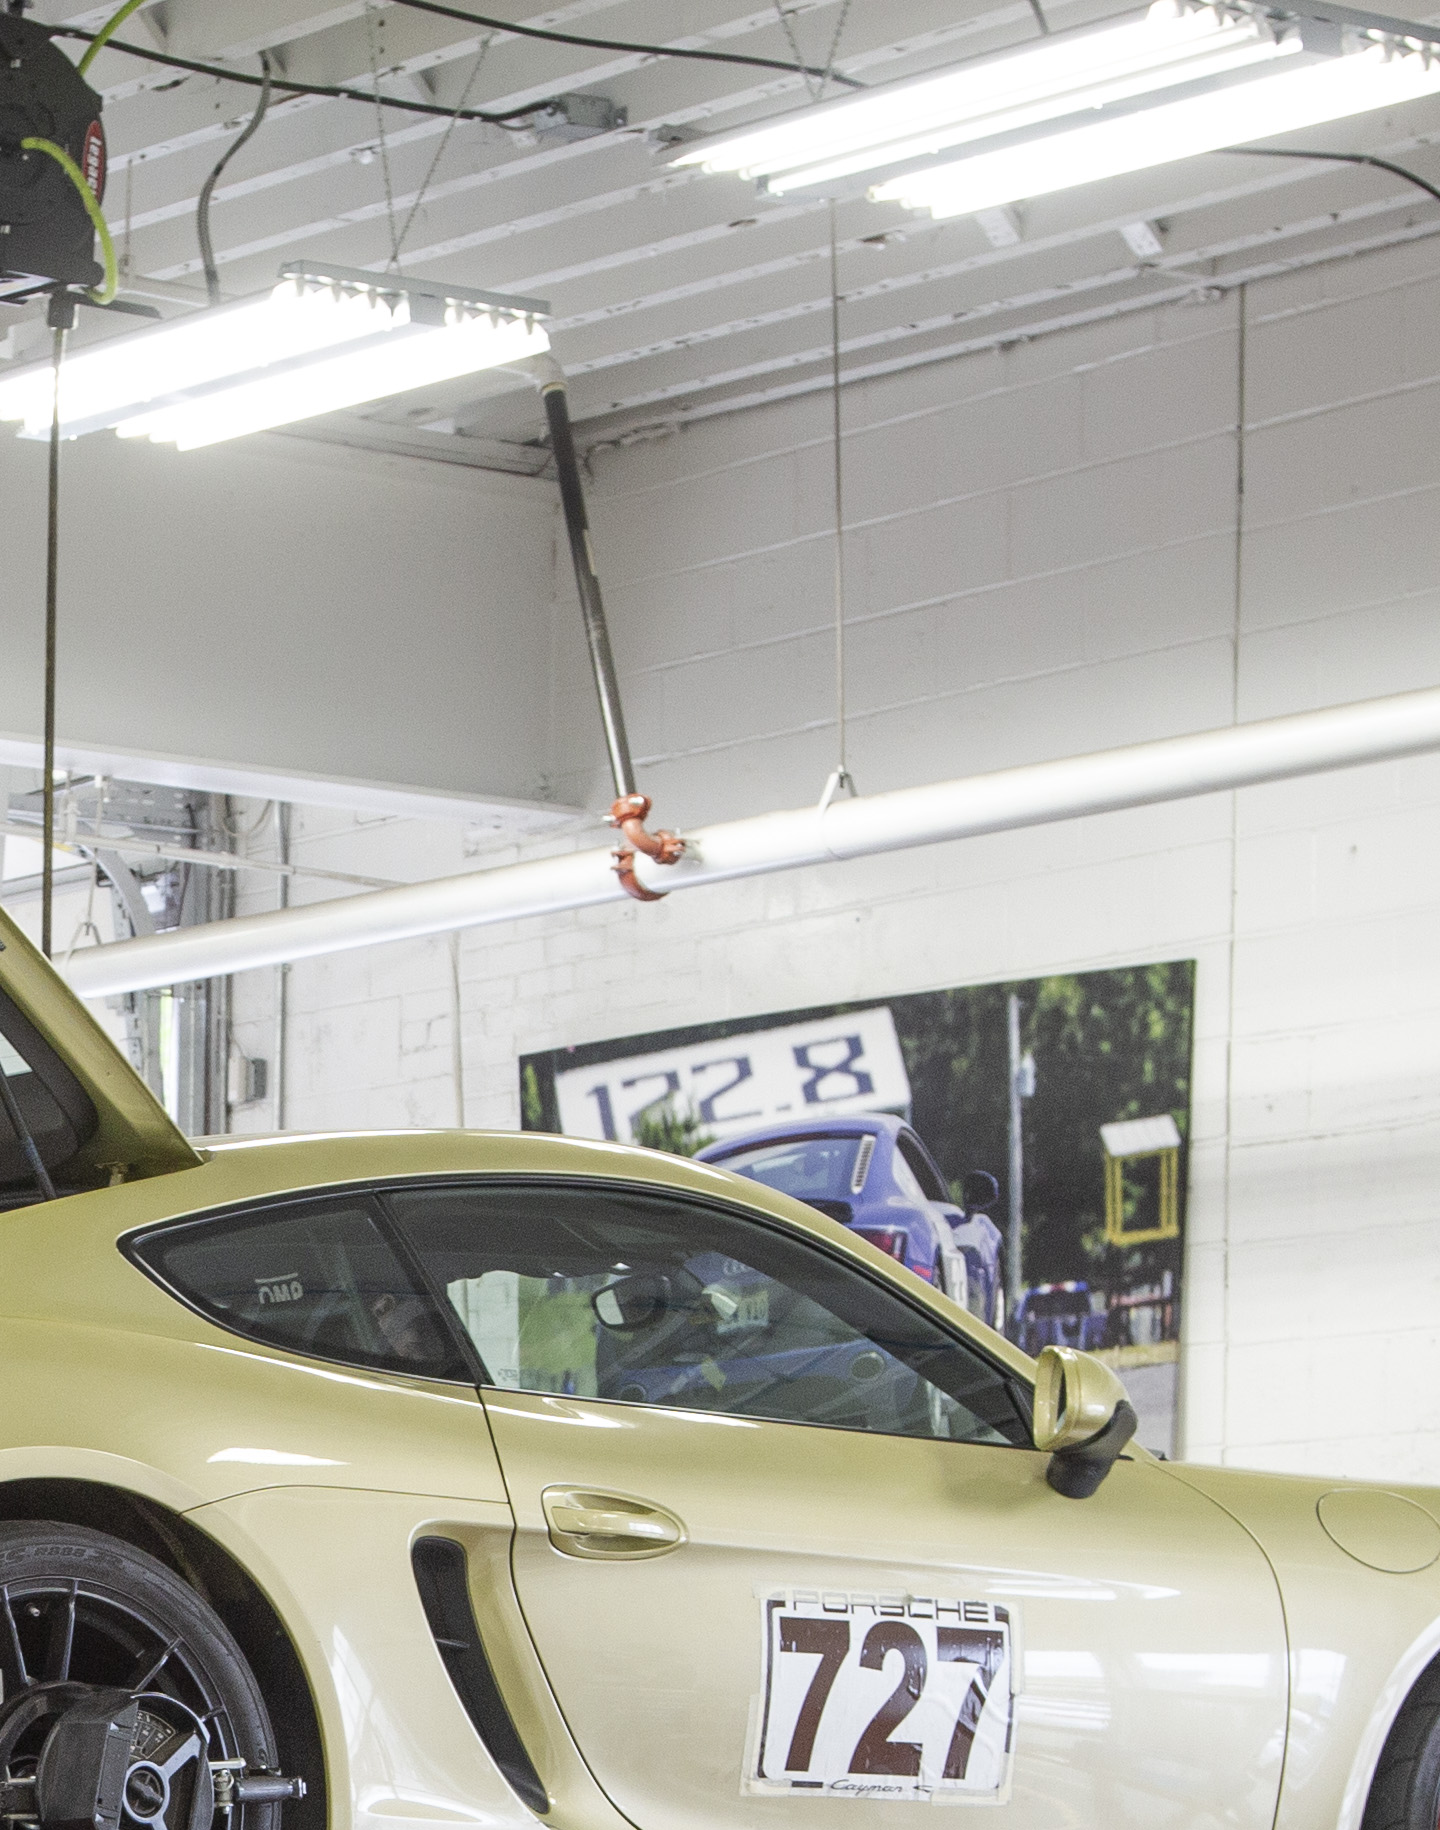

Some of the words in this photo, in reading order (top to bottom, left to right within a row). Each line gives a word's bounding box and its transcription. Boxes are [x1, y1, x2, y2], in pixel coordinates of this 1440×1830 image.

[792, 1589, 989, 1623] PORSCHE
[779, 1615, 1005, 1780] 727
[830, 1780, 903, 1795] Cayman
